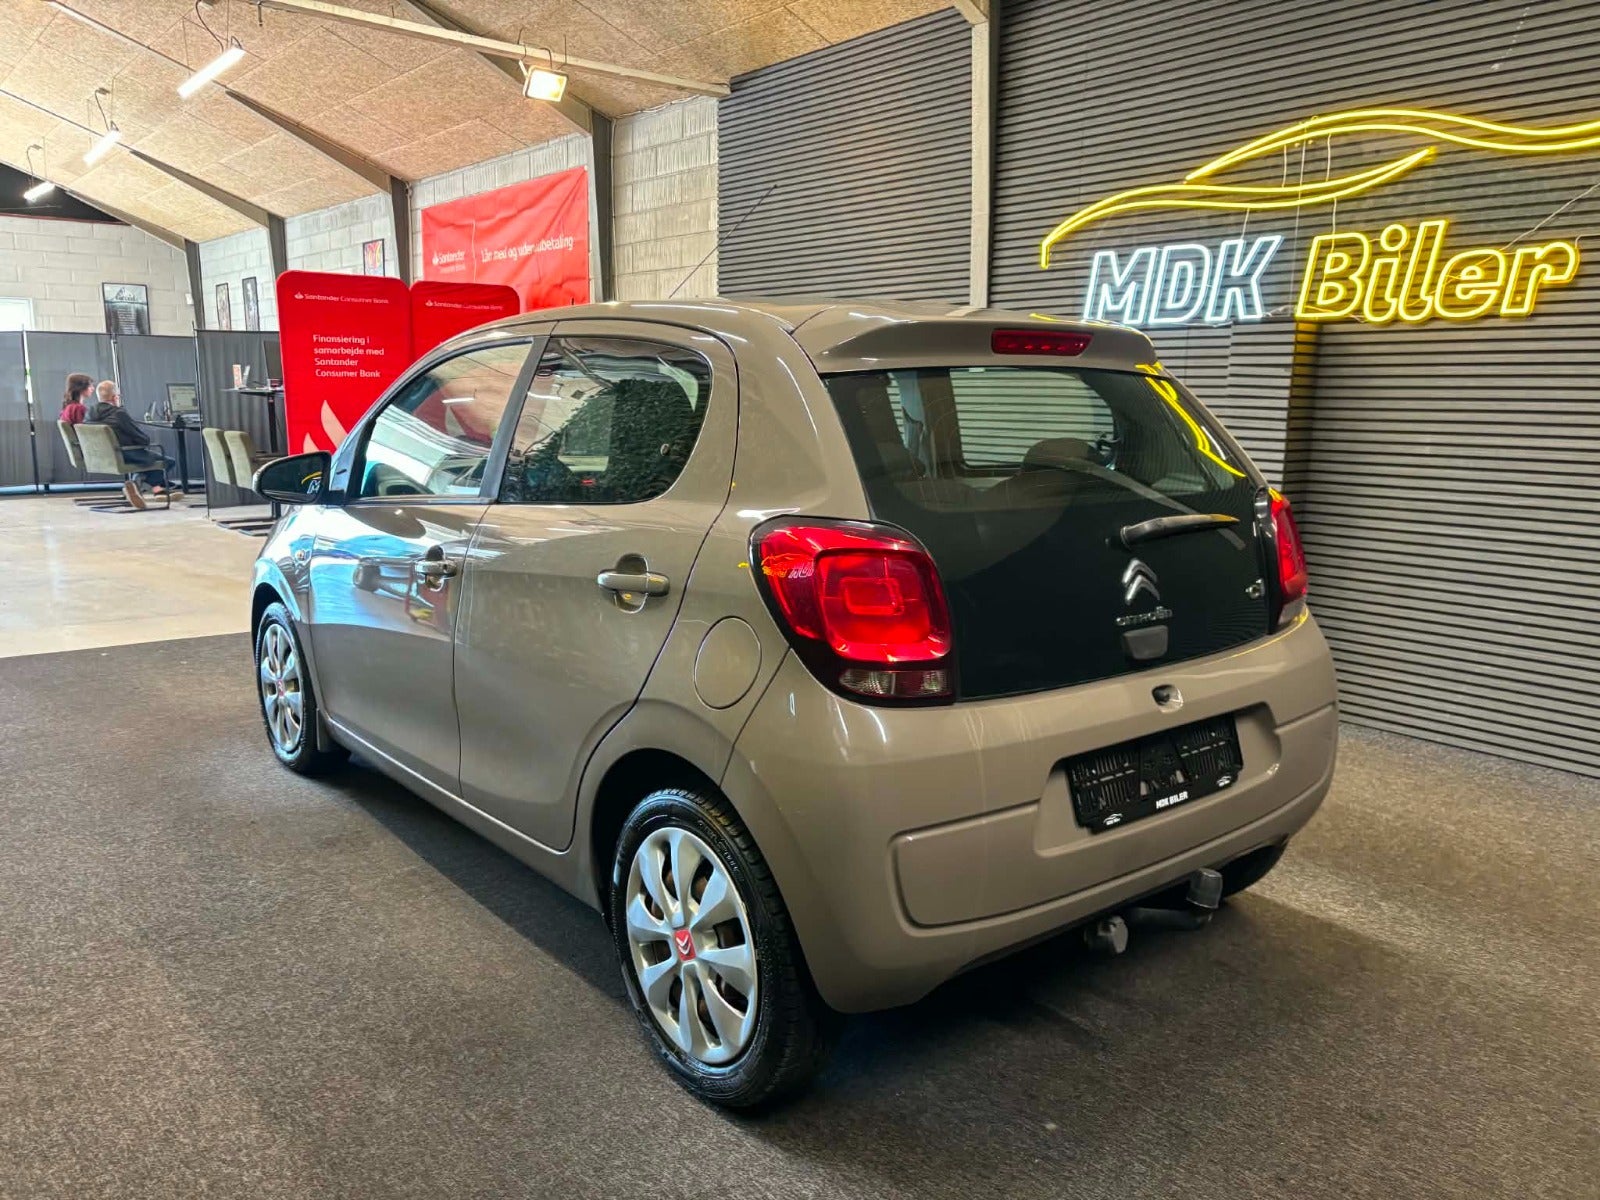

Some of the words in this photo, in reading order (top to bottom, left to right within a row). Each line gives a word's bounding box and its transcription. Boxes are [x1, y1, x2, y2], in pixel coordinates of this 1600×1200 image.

[508, 246, 517, 261] og
[1082, 235, 1283, 325] MDK
[1295, 219, 1580, 322] Biler
[304, 293, 339, 302] Santander
[313, 334, 365, 345] Finansiering
[314, 346, 364, 357] samarbejde
[366, 347, 385, 356] med
[314, 357, 358, 366] Santander
[315, 369, 358, 378] Consumer
[359, 369, 381, 378] Bank
[1169, 791, 1188, 805] BILER
